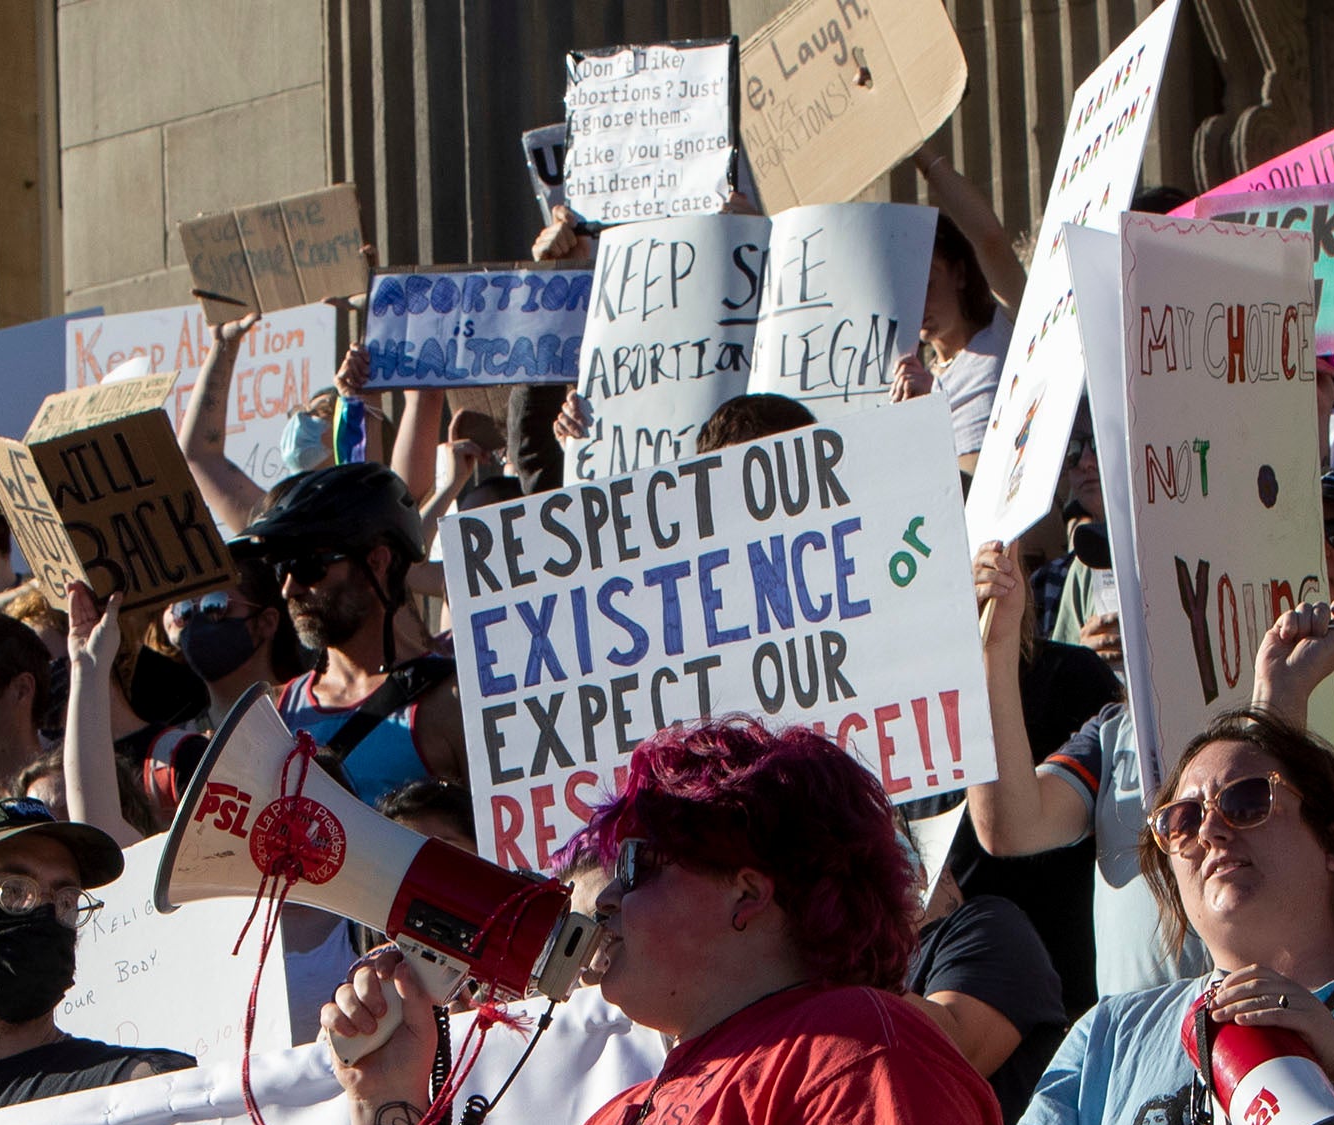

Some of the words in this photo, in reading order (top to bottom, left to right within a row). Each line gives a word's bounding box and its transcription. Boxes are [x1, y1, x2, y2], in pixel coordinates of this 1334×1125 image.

[569, 81, 674, 107] abortions?
[678, 80, 720, 99] Just
[640, 52, 681, 70] like
[1073, 44, 1146, 137] AGAINST
[572, 111, 634, 136] ignore
[640, 108, 689, 126] them.
[574, 146, 614, 167] Like
[628, 144, 659, 163] you
[666, 135, 727, 160] ignore
[1058, 85, 1151, 196] ABORTION?
[567, 173, 652, 196] children
[658, 170, 677, 188] in
[602, 199, 665, 221] foster
[672, 195, 721, 213] care.
[594, 238, 696, 322] KEEP
[780, 313, 898, 403] LEGAL
[1140, 304, 1194, 376] MY
[1203, 303, 1315, 384] CHOICE
[1145, 437, 1210, 503] NOT
[459, 455, 723, 597] RESPECT
[742, 429, 850, 521] OUR
[470, 517, 872, 697] EXISTENCE
[889, 516, 931, 588] or
[482, 655, 722, 786] EXPECT
[753, 630, 857, 715] OUR
[194, 794, 250, 839] PSL
